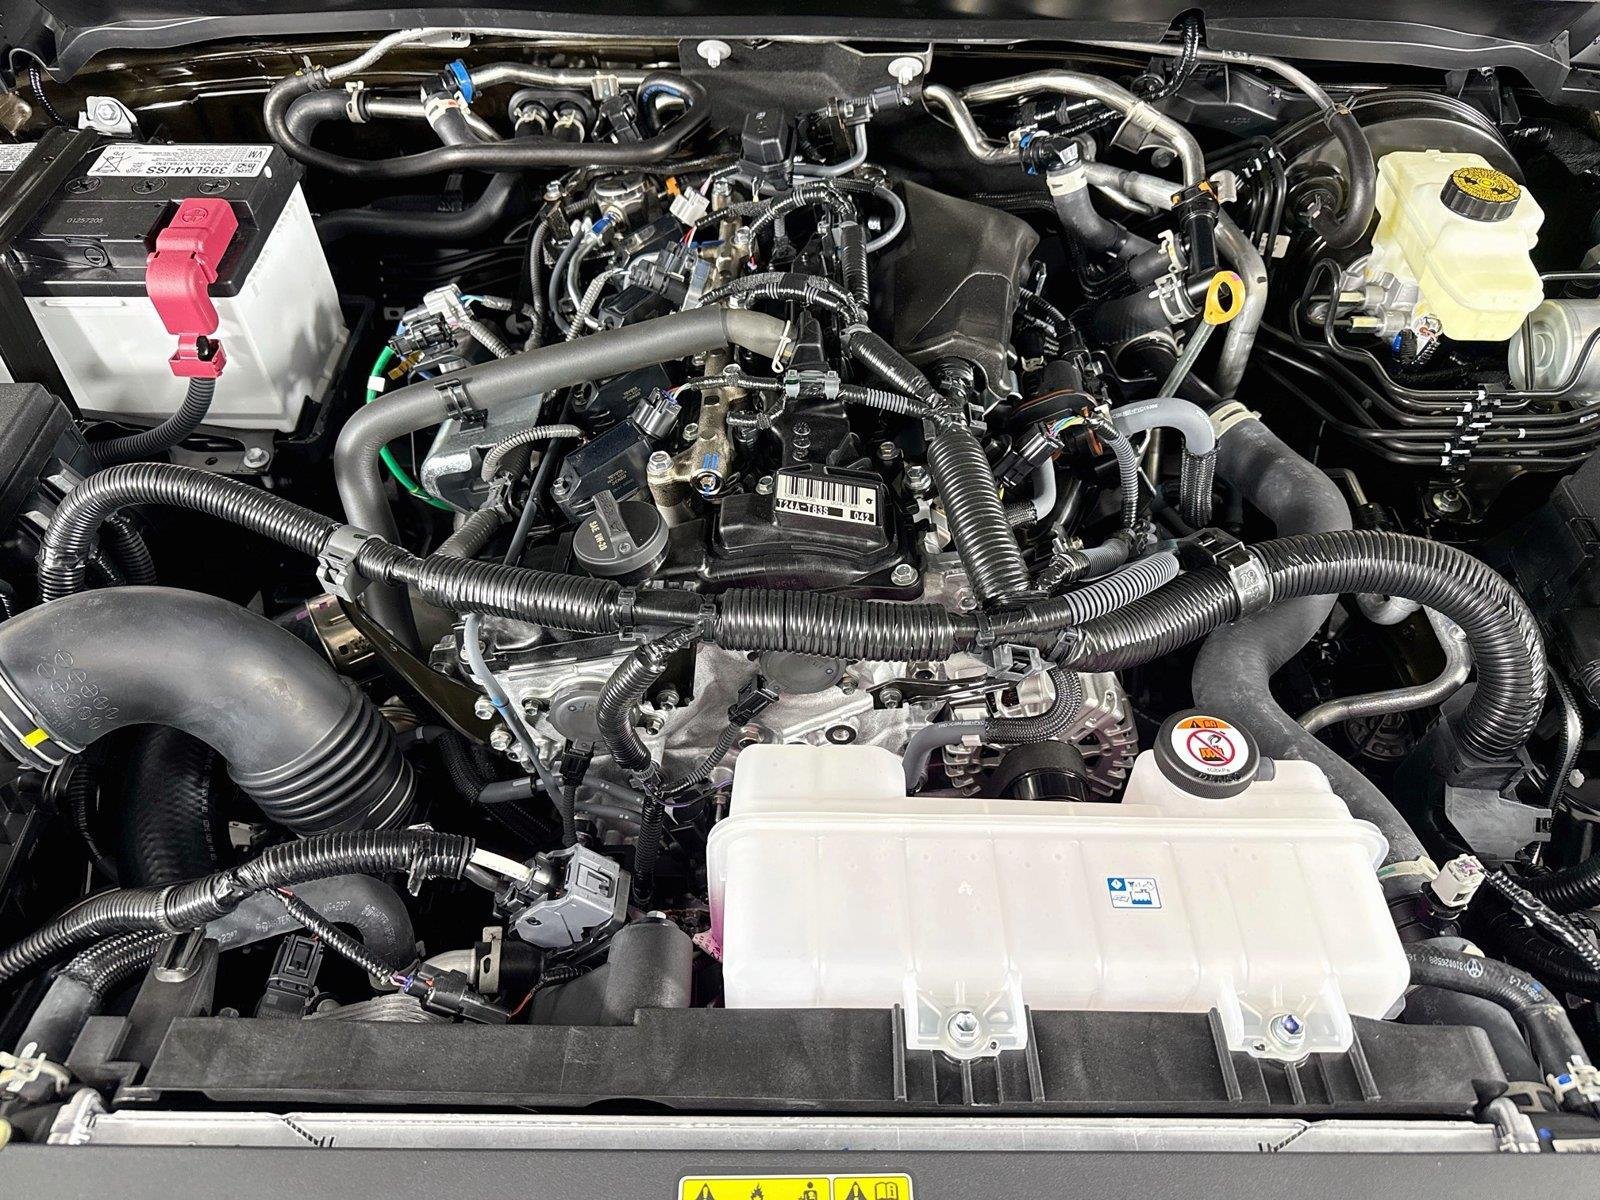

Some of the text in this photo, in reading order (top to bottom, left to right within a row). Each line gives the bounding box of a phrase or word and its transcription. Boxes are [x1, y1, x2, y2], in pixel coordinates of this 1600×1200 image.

[248, 150, 262, 158] VM
[146, 166, 228, 175] 395LN4-ISS
[853, 510, 870, 521] 042
[589, 520, 608, 551] SAE 0W-20
